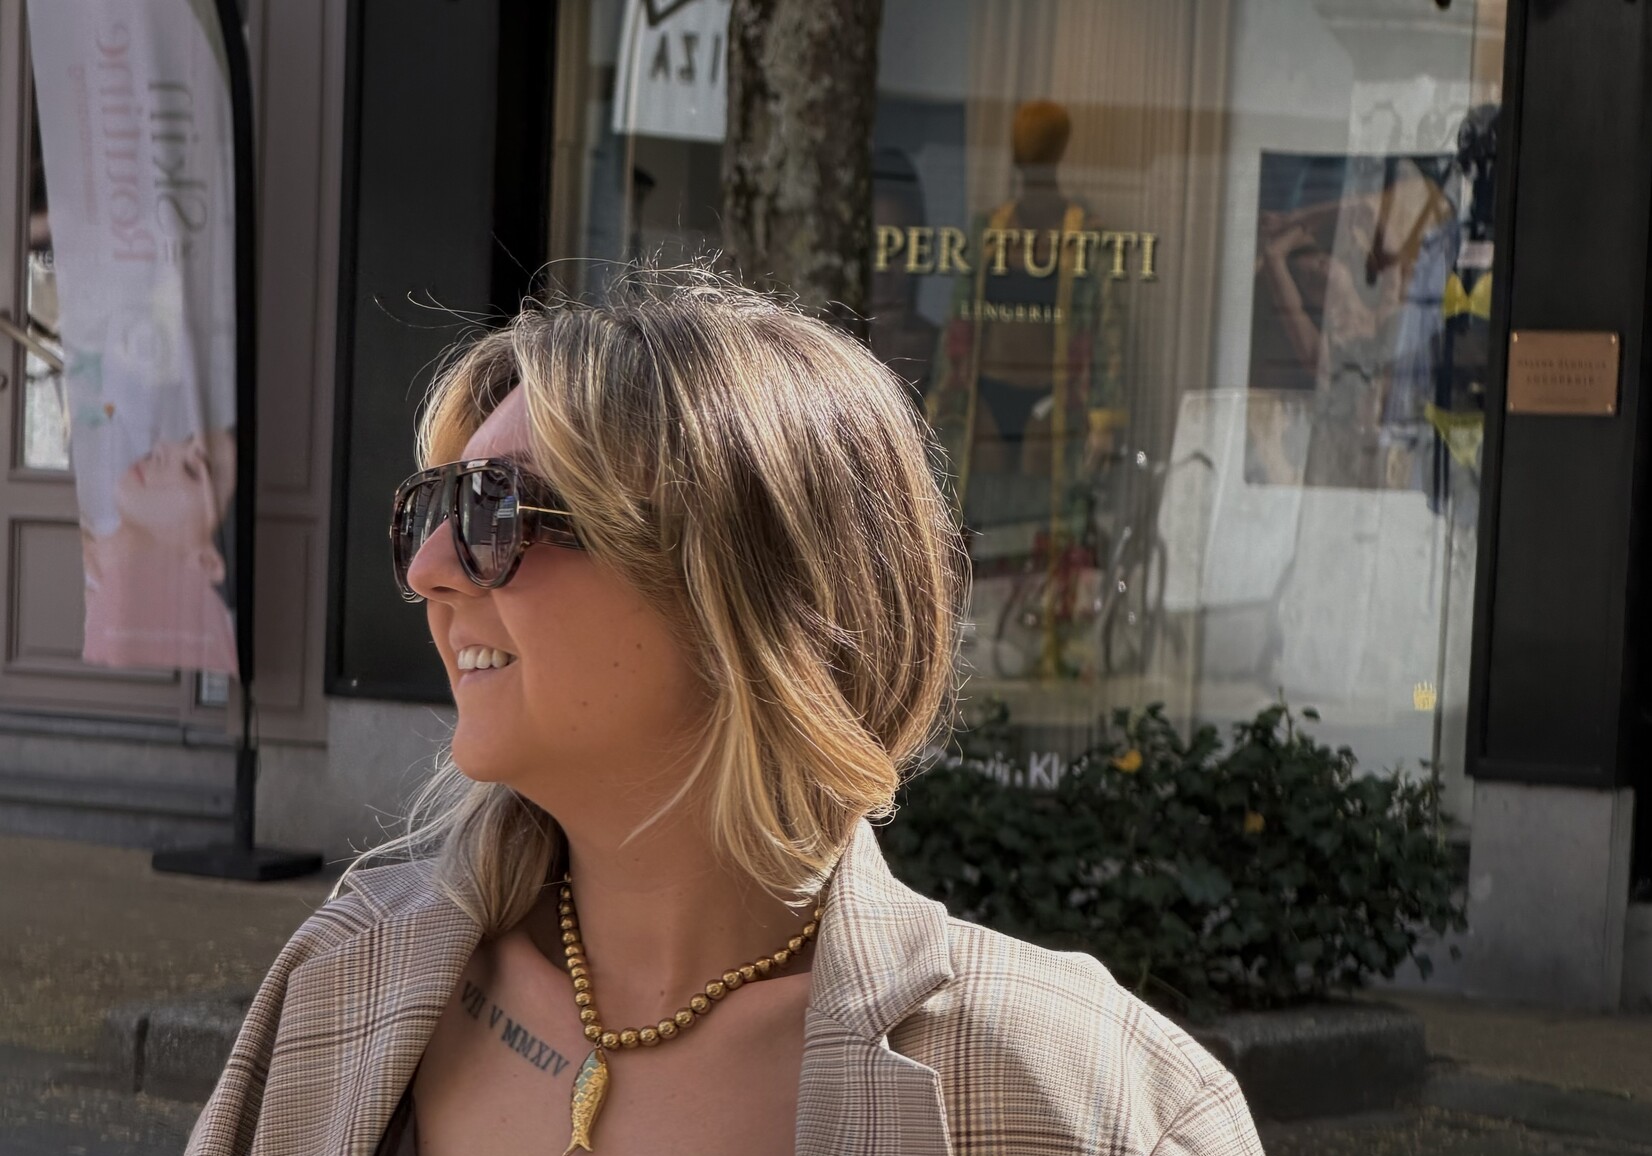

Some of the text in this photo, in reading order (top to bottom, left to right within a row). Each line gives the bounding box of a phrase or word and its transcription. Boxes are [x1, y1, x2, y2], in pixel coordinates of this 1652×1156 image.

[874, 225, 1158, 281] PER TUTTI
[488, 1004, 504, 1030] V
[501, 1017, 571, 1077] MMXIV
